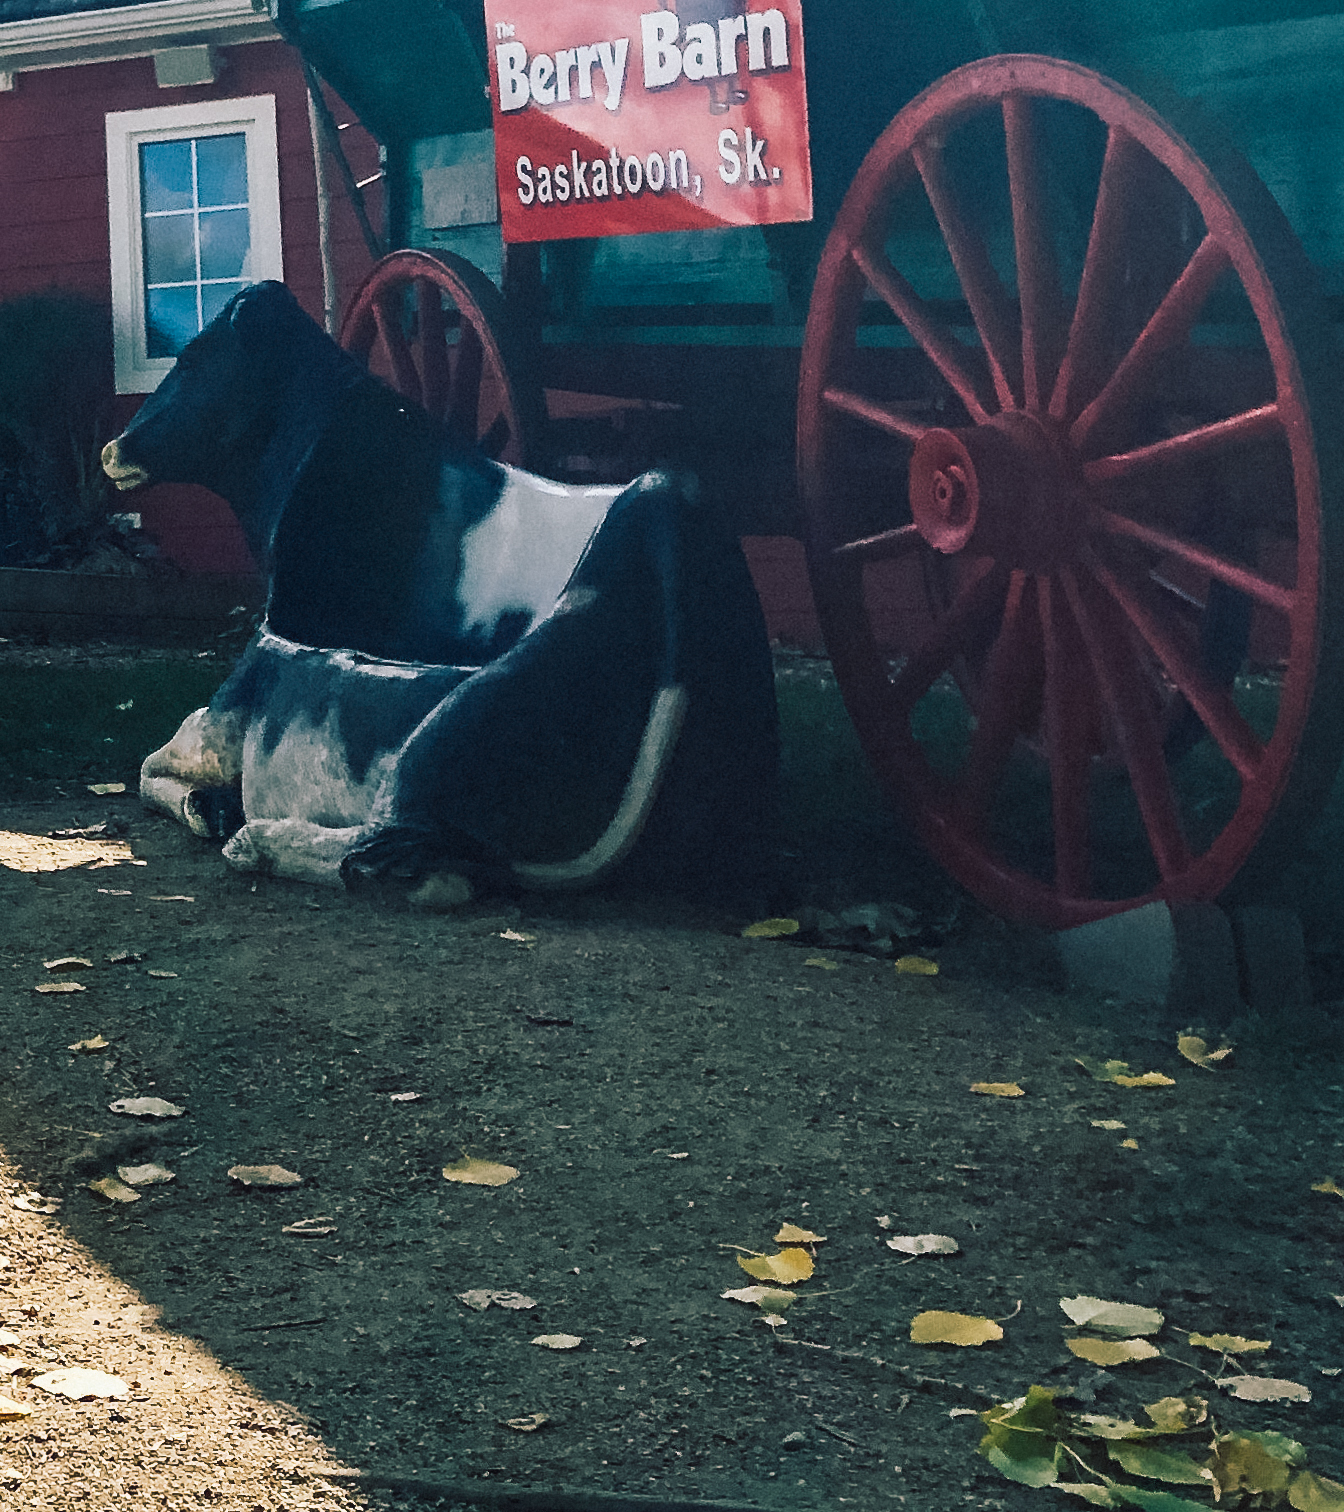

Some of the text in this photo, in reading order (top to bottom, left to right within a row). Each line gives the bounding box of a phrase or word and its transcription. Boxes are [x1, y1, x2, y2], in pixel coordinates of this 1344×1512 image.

[495, 21, 516, 39] The
[496, 8, 790, 112] Berry Barn
[516, 127, 781, 206] Saskatoon, Sk.
